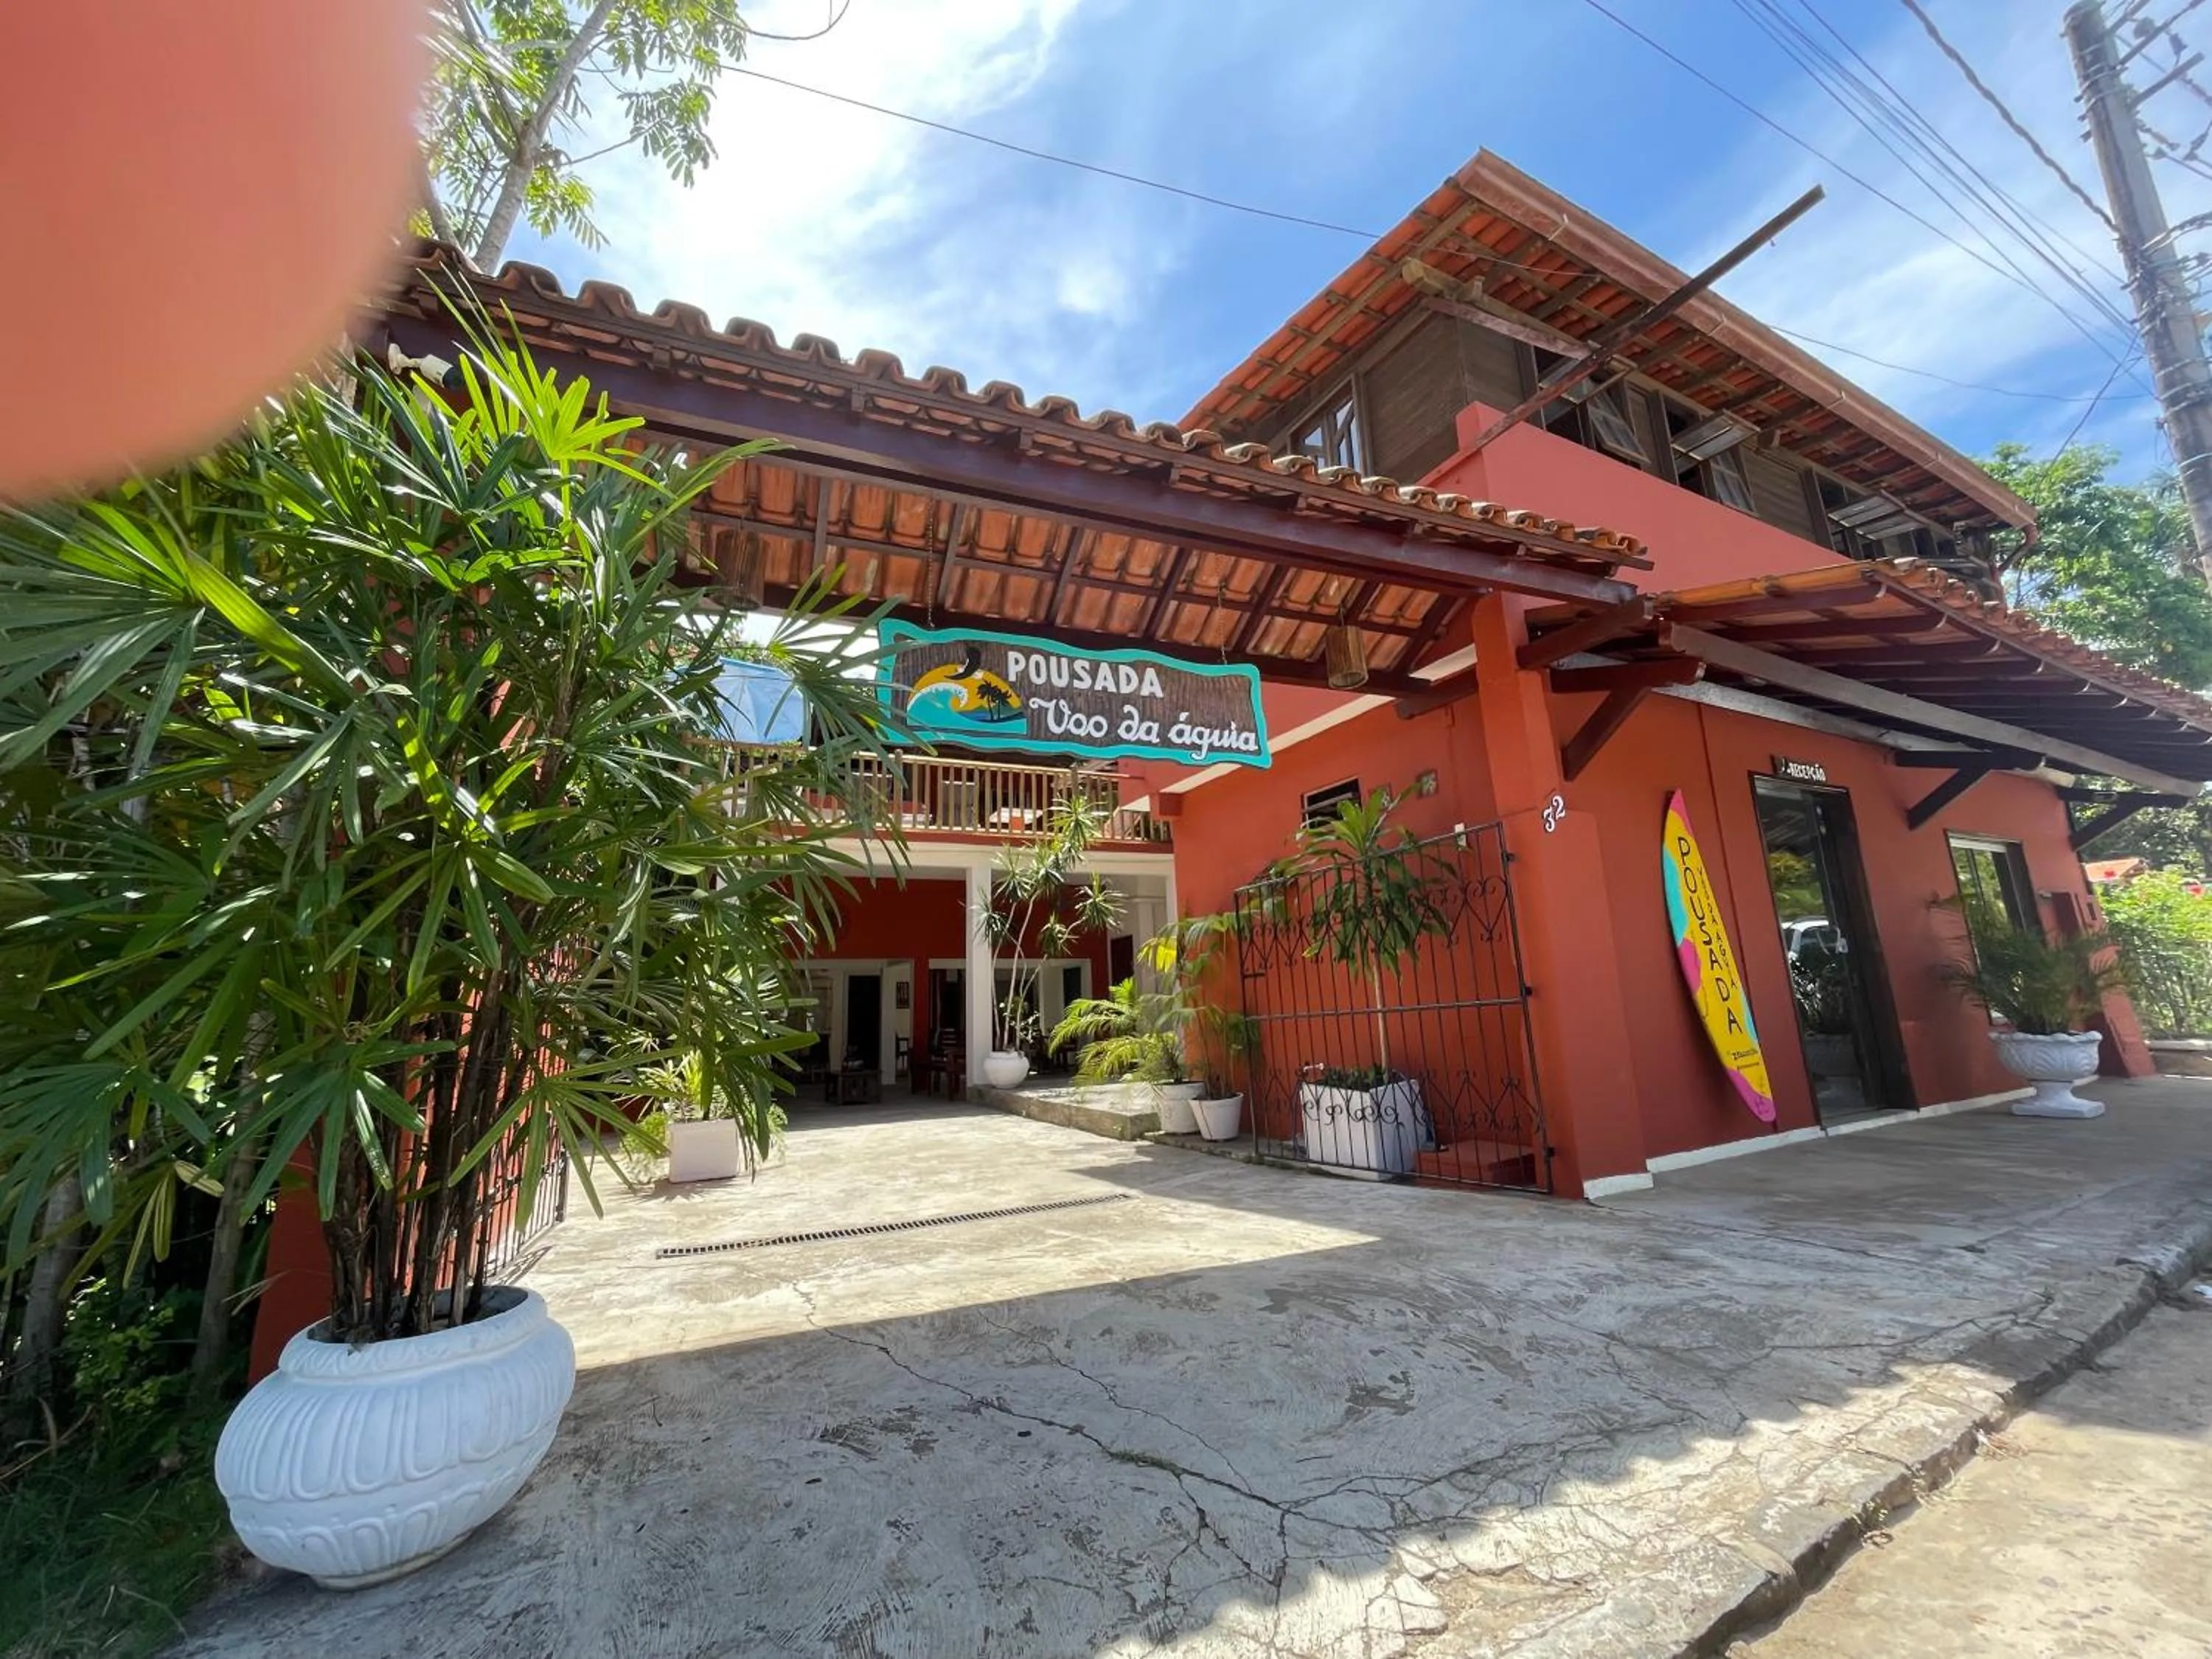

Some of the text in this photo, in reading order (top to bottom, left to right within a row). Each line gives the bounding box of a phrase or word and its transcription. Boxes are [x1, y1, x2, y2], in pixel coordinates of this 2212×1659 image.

[1007, 651, 1164, 698] POUSADA
[1029, 697, 1259, 760] Voo da águia
[1543, 795, 1565, 832] 32
[1677, 837, 1742, 1034] POUSADA
